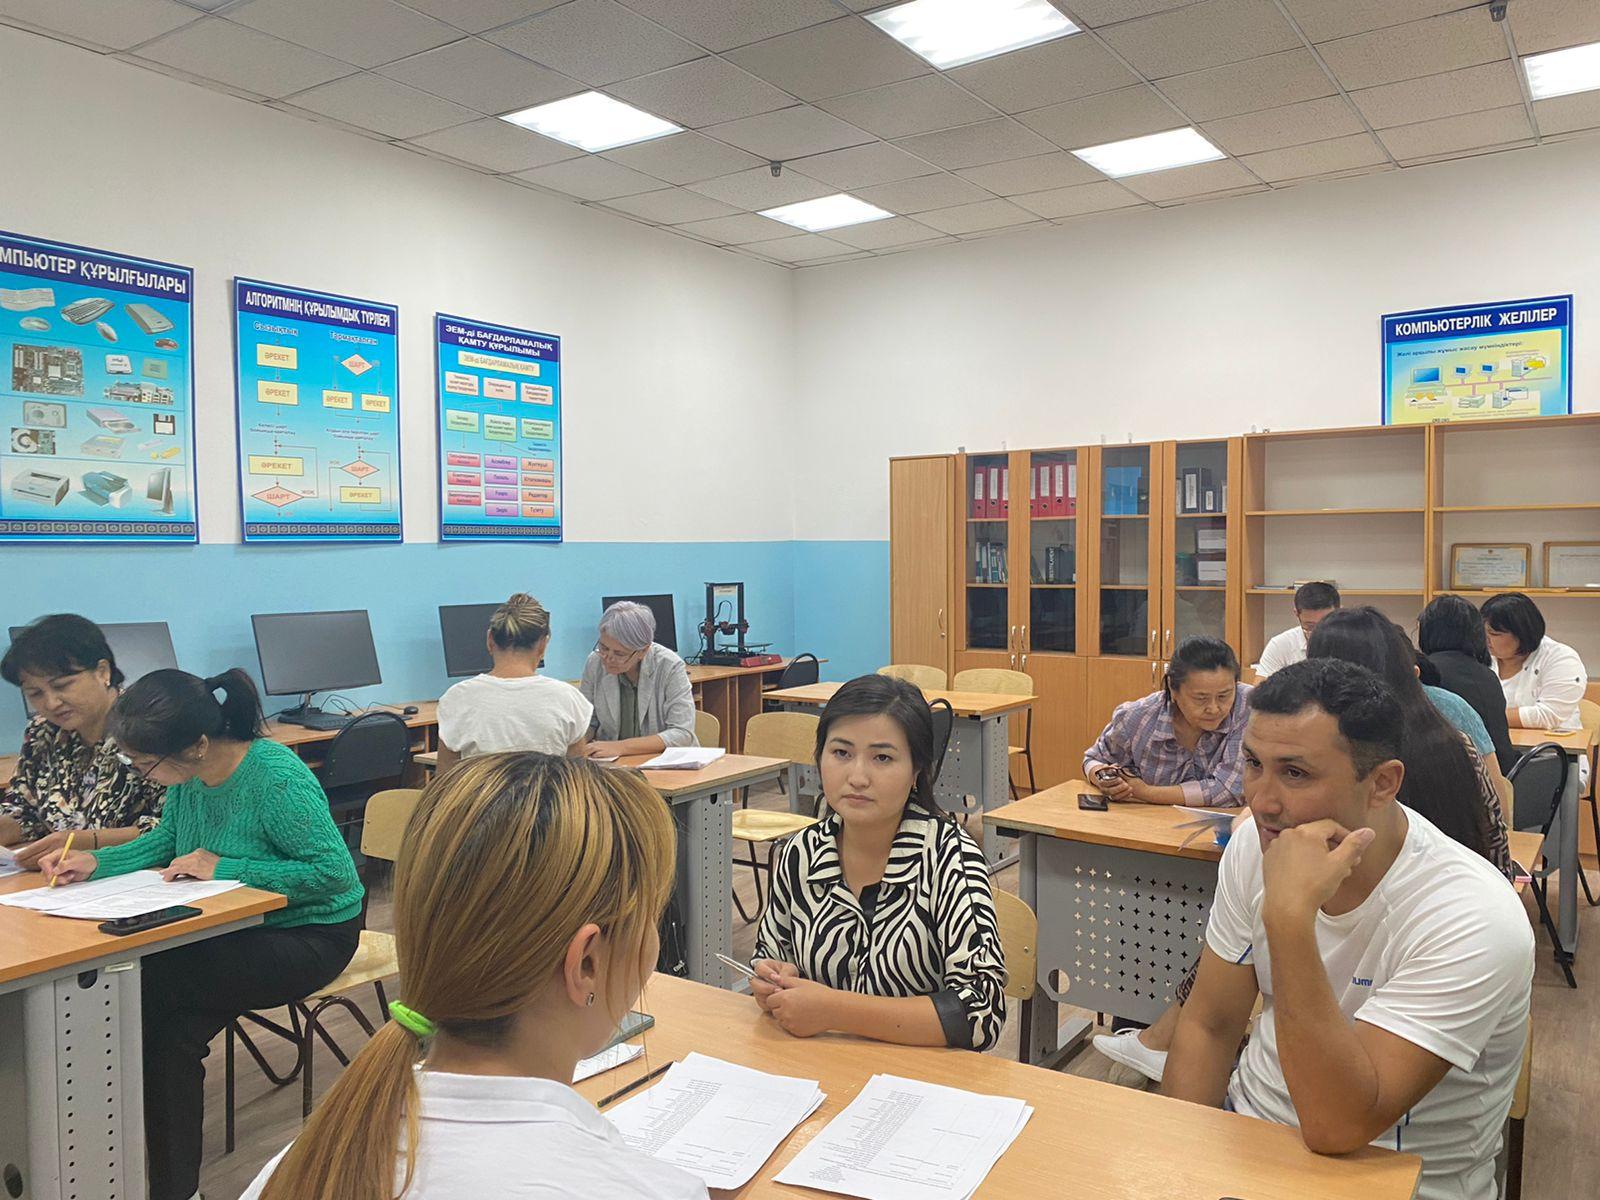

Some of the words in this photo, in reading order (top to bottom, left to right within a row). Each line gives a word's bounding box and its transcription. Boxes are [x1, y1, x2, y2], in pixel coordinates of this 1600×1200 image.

[80, 261, 186, 294] ҚҰРЫЛҒЫЛАРЫ
[245, 291, 303, 316] АЛГОРИТМНІҢ
[304, 300, 359, 325] ҚҰРЫЛЫМДЫҚ
[361, 311, 390, 327] ТҮРЛЕРІ
[1395, 314, 1492, 336] КОМПЬЮТЕРЛІК
[1498, 307, 1558, 326] ЖЕЛІЛЕР
[445, 324, 476, 337] ЭЕМ-ді
[476, 331, 553, 351] БАҒДАРЛАМАЛЫҚ
[458, 337, 487, 348] ҚАМТУ
[489, 343, 540, 357] ҚҰРЫЛЫМЫ
